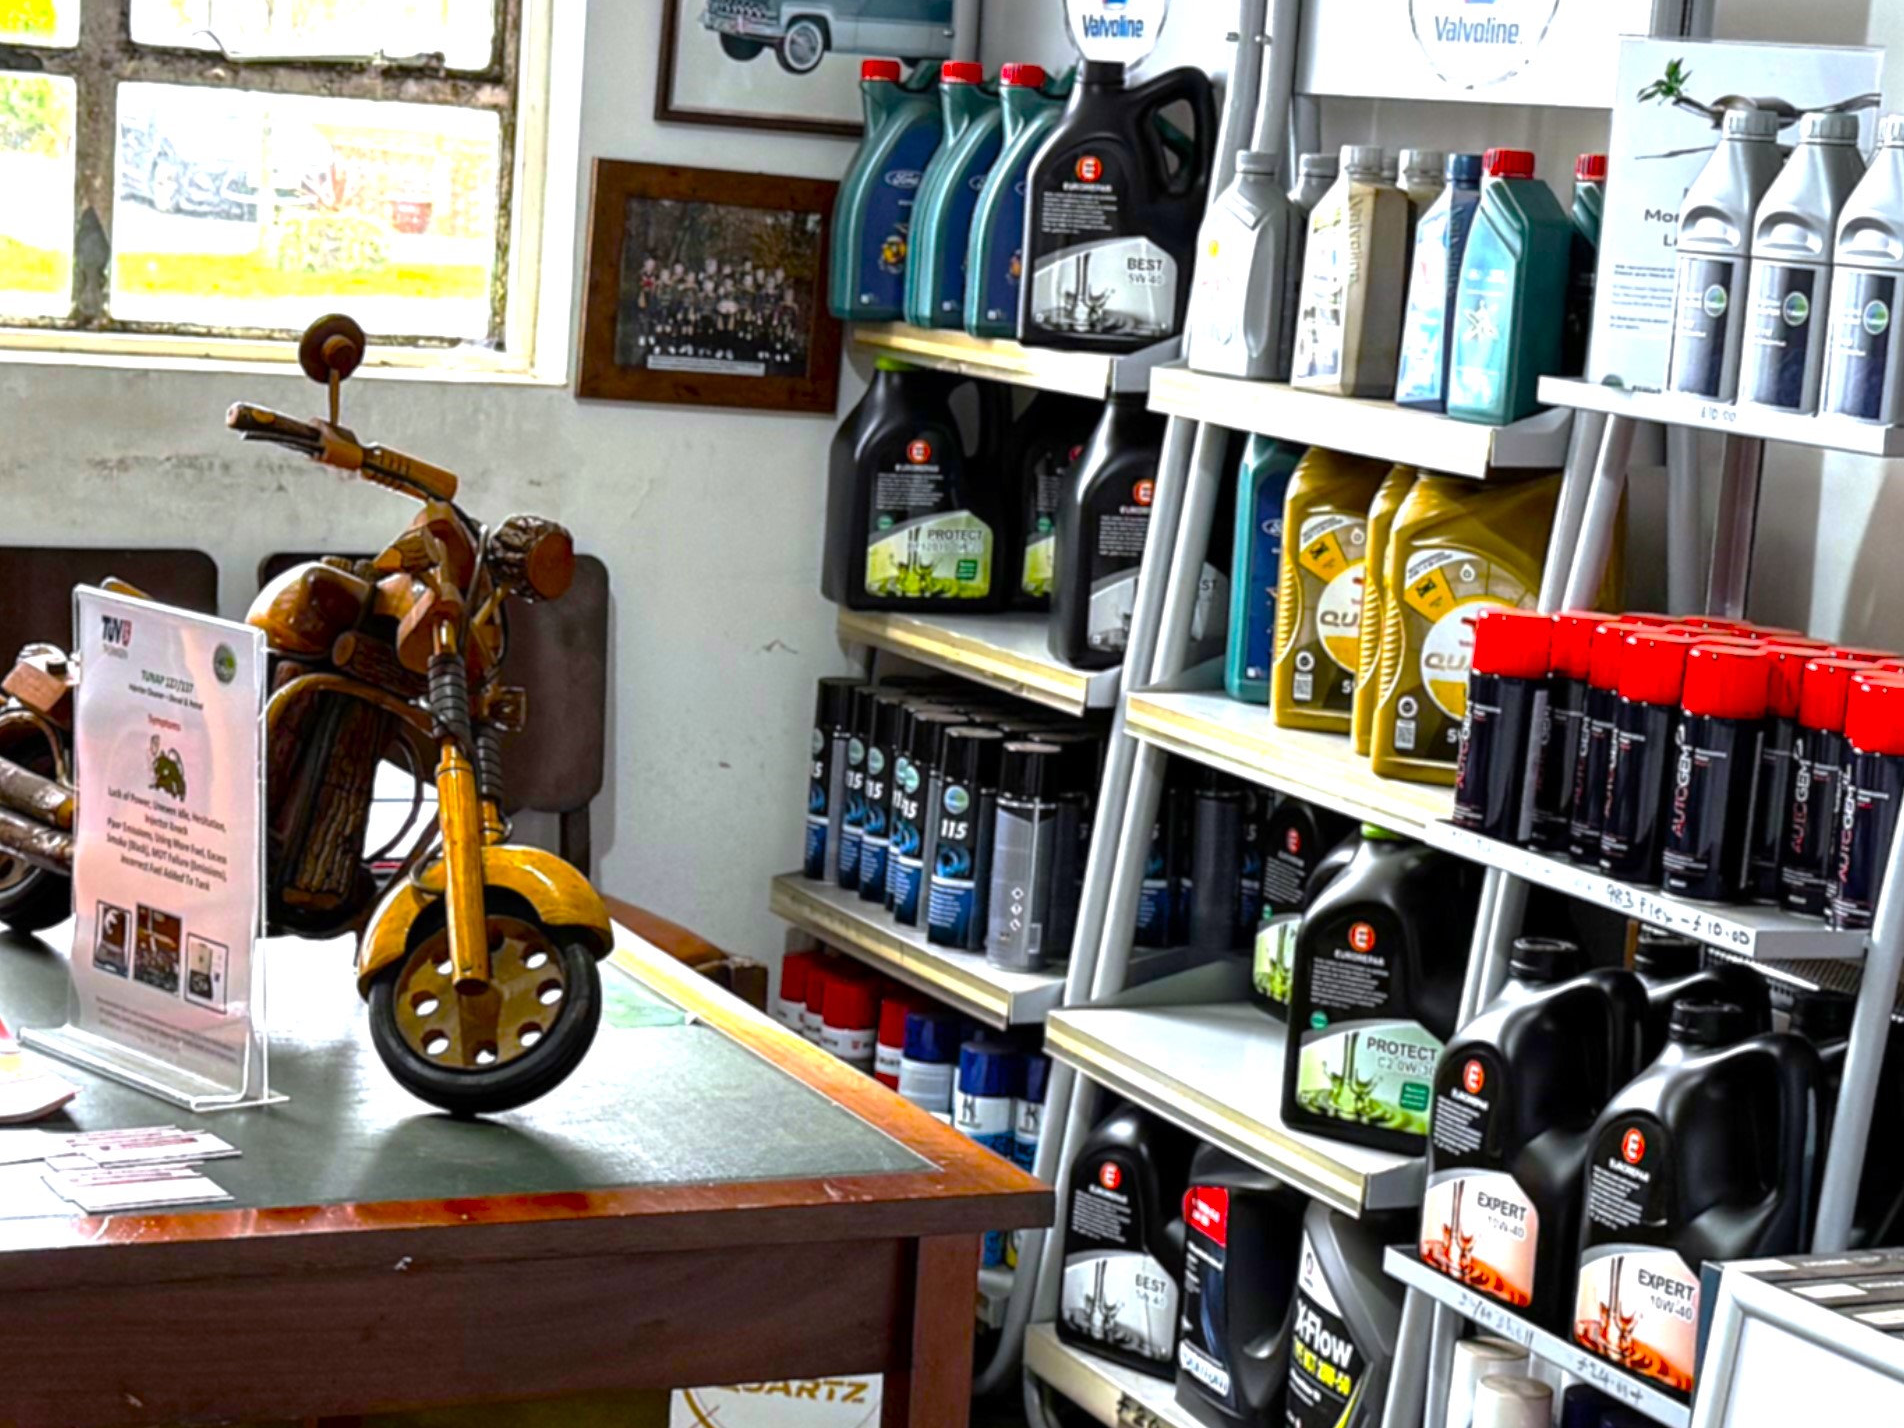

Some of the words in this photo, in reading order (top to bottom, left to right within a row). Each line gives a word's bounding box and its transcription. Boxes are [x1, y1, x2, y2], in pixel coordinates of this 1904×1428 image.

[1081, 13, 1144, 41] Valvoline
[1434, 16, 1521, 45] Valvoline
[1126, 258, 1164, 271] BEST
[927, 529, 983, 542] PROTECT
[148, 712, 181, 734] Symptoms
[1671, 743, 1694, 839] AUTOGEM
[107, 785, 121, 800] Lack
[123, 790, 129, 802] of
[131, 792, 150, 809] Power,
[153, 799, 176, 816] Uneven
[177, 807, 190, 821] Idle,
[191, 812, 226, 833] Hesitation,
[1791, 758, 1812, 854] AUTOGEM
[107, 816, 121, 831] Poor
[122, 821, 153, 841] Emissions,
[154, 832, 172, 849] Using
[173, 837, 189, 852] More
[190, 843, 205, 858] Fuel,
[206, 848, 226, 865] Excess
[169, 821, 187, 836] Knock
[939, 819, 968, 840] 115
[1838, 784, 1857, 883] AUTOGEM
[106, 831, 126, 848] Smoke
[127, 838, 150, 858] (Black),
[152, 845, 167, 861] MOT
[168, 851, 189, 869] Failure
[190, 858, 226, 883] (Emissions),
[120, 853, 148, 872] Incorrect
[149, 862, 162, 876] Fuel
[163, 866, 184, 883] Added
[185, 873, 192, 886] To
[194, 876, 210, 892] Tank
[1365, 1035, 1439, 1062] PROTECT
[1477, 1191, 1528, 1223] EXPERT
[1133, 1274, 1167, 1293] BEST
[1637, 1267, 1696, 1302] EXPERT
[1650, 1293, 1694, 1321] 10W-40
